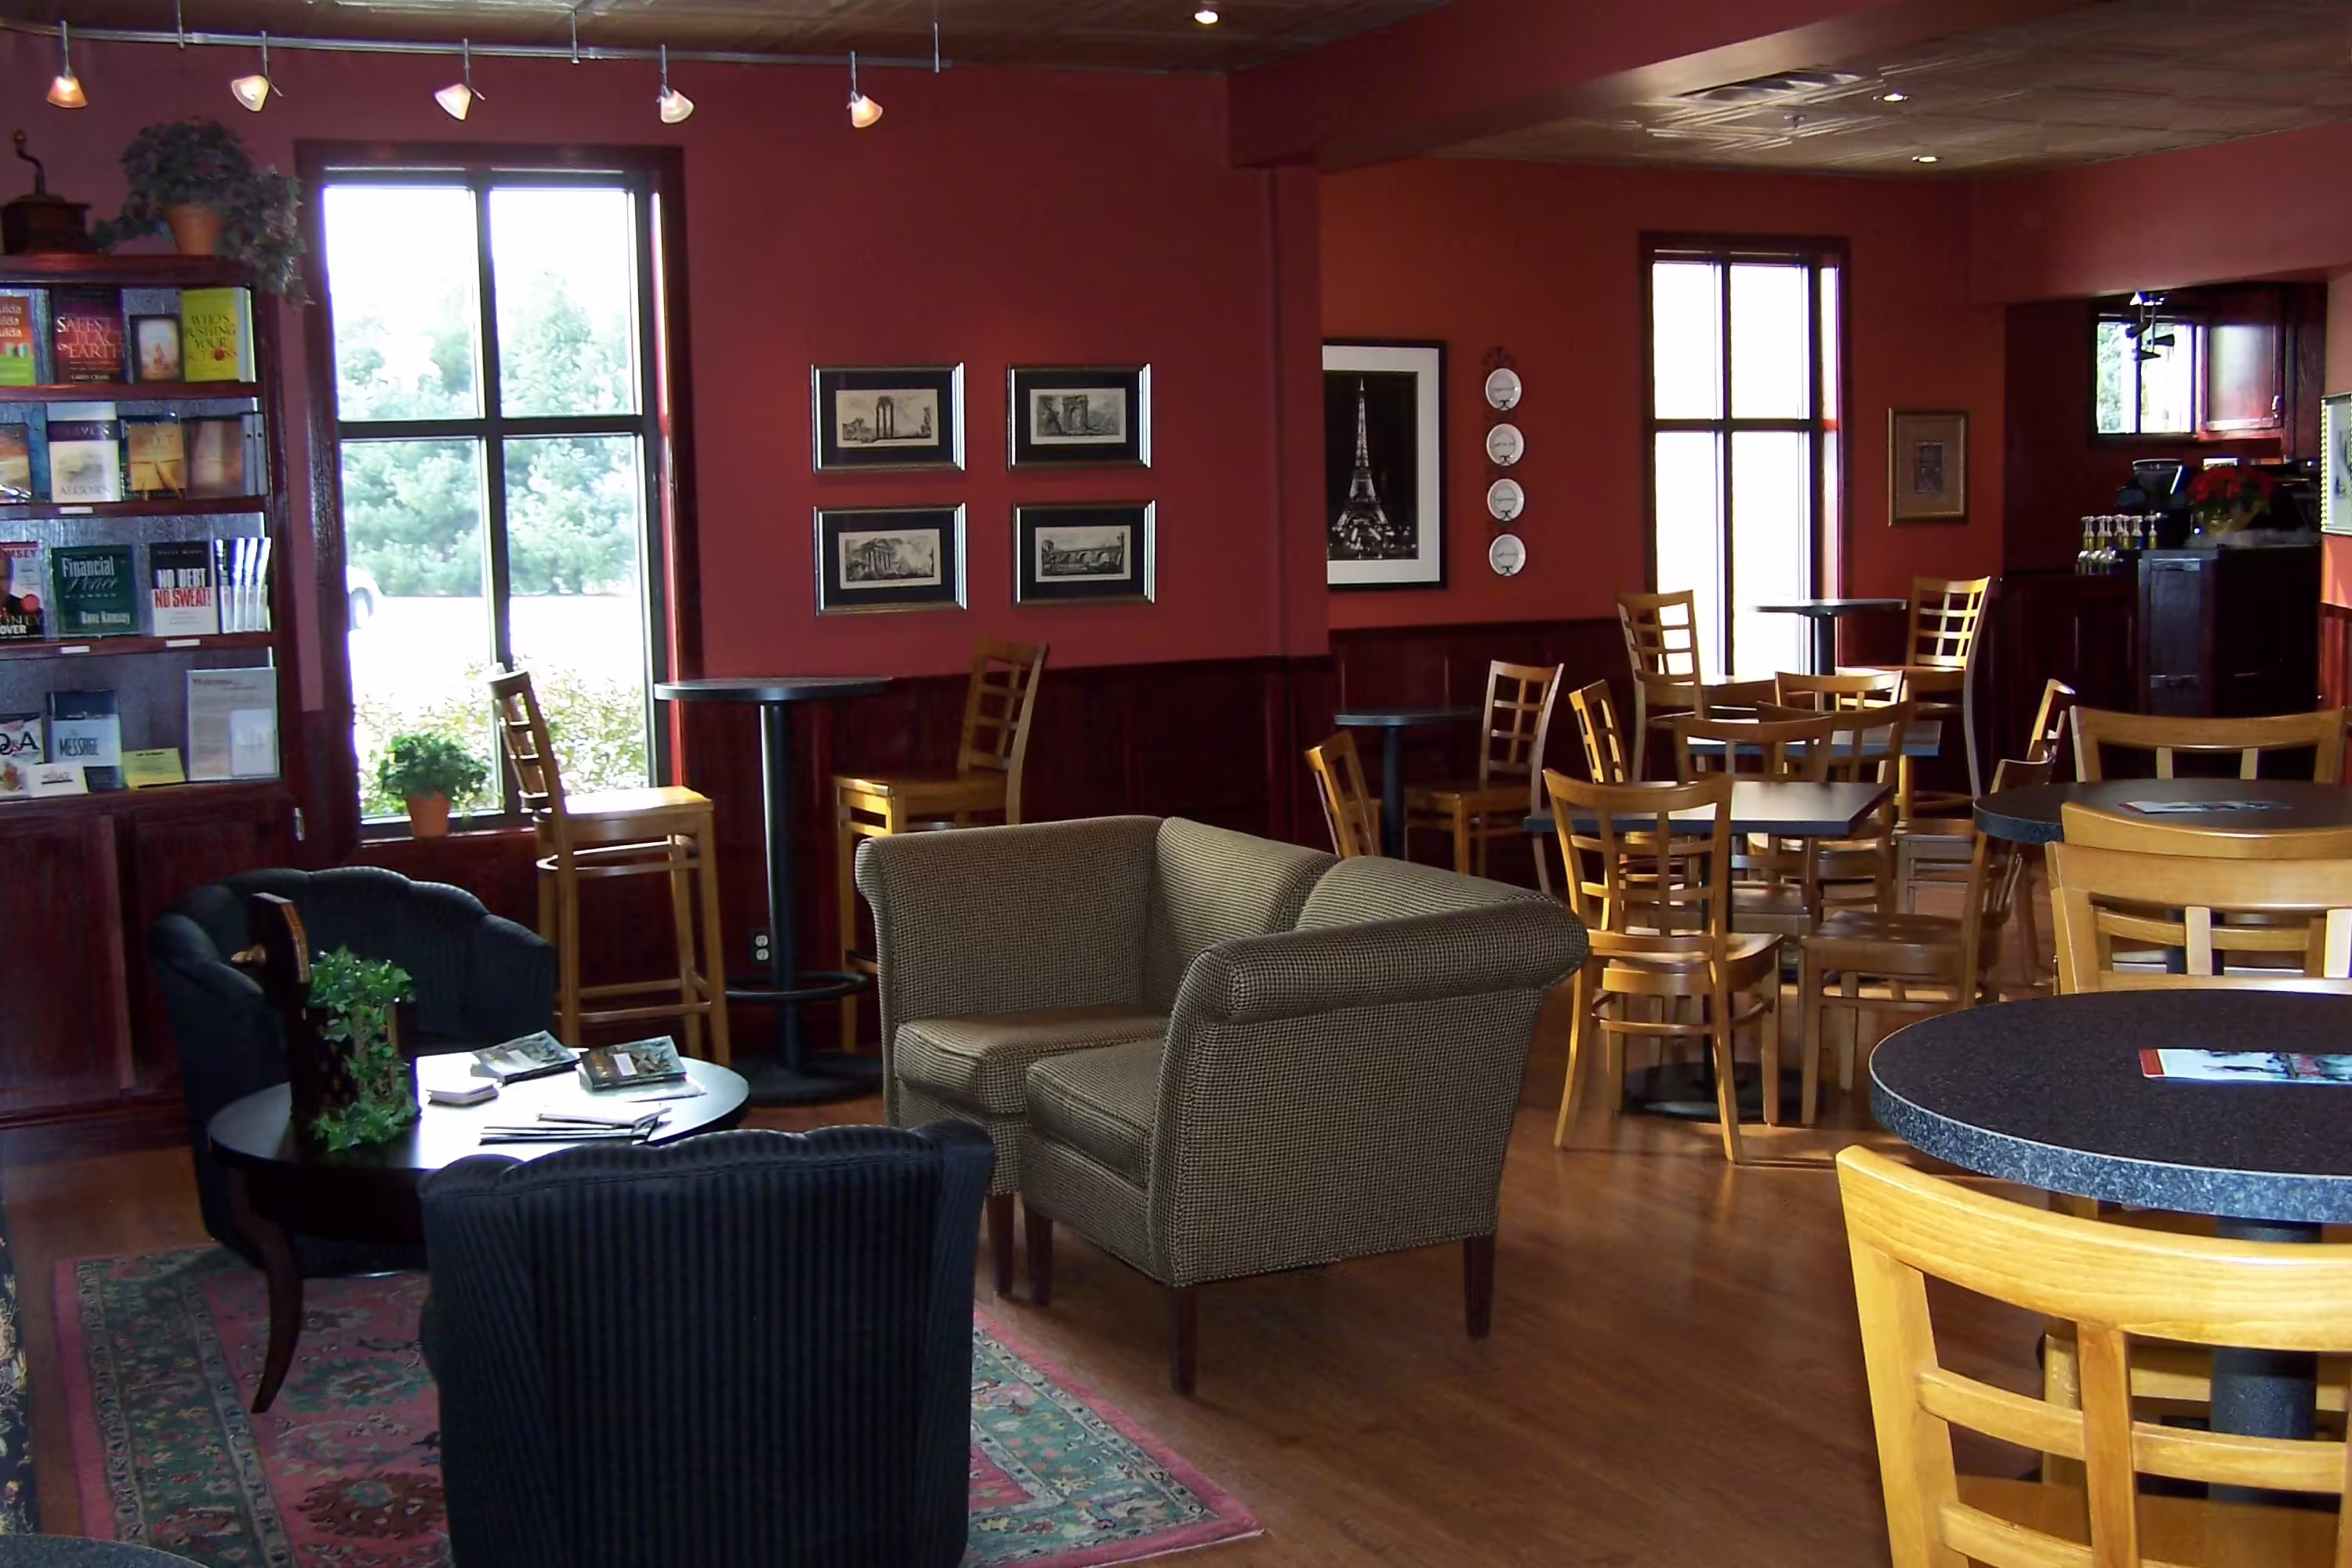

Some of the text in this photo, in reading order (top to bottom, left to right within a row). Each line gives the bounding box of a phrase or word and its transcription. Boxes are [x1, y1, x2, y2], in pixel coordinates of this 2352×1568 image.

[62, 556, 115, 579] Financial
[157, 568, 206, 589] NO DEBT
[154, 587, 212, 608] NO SWEAT!
